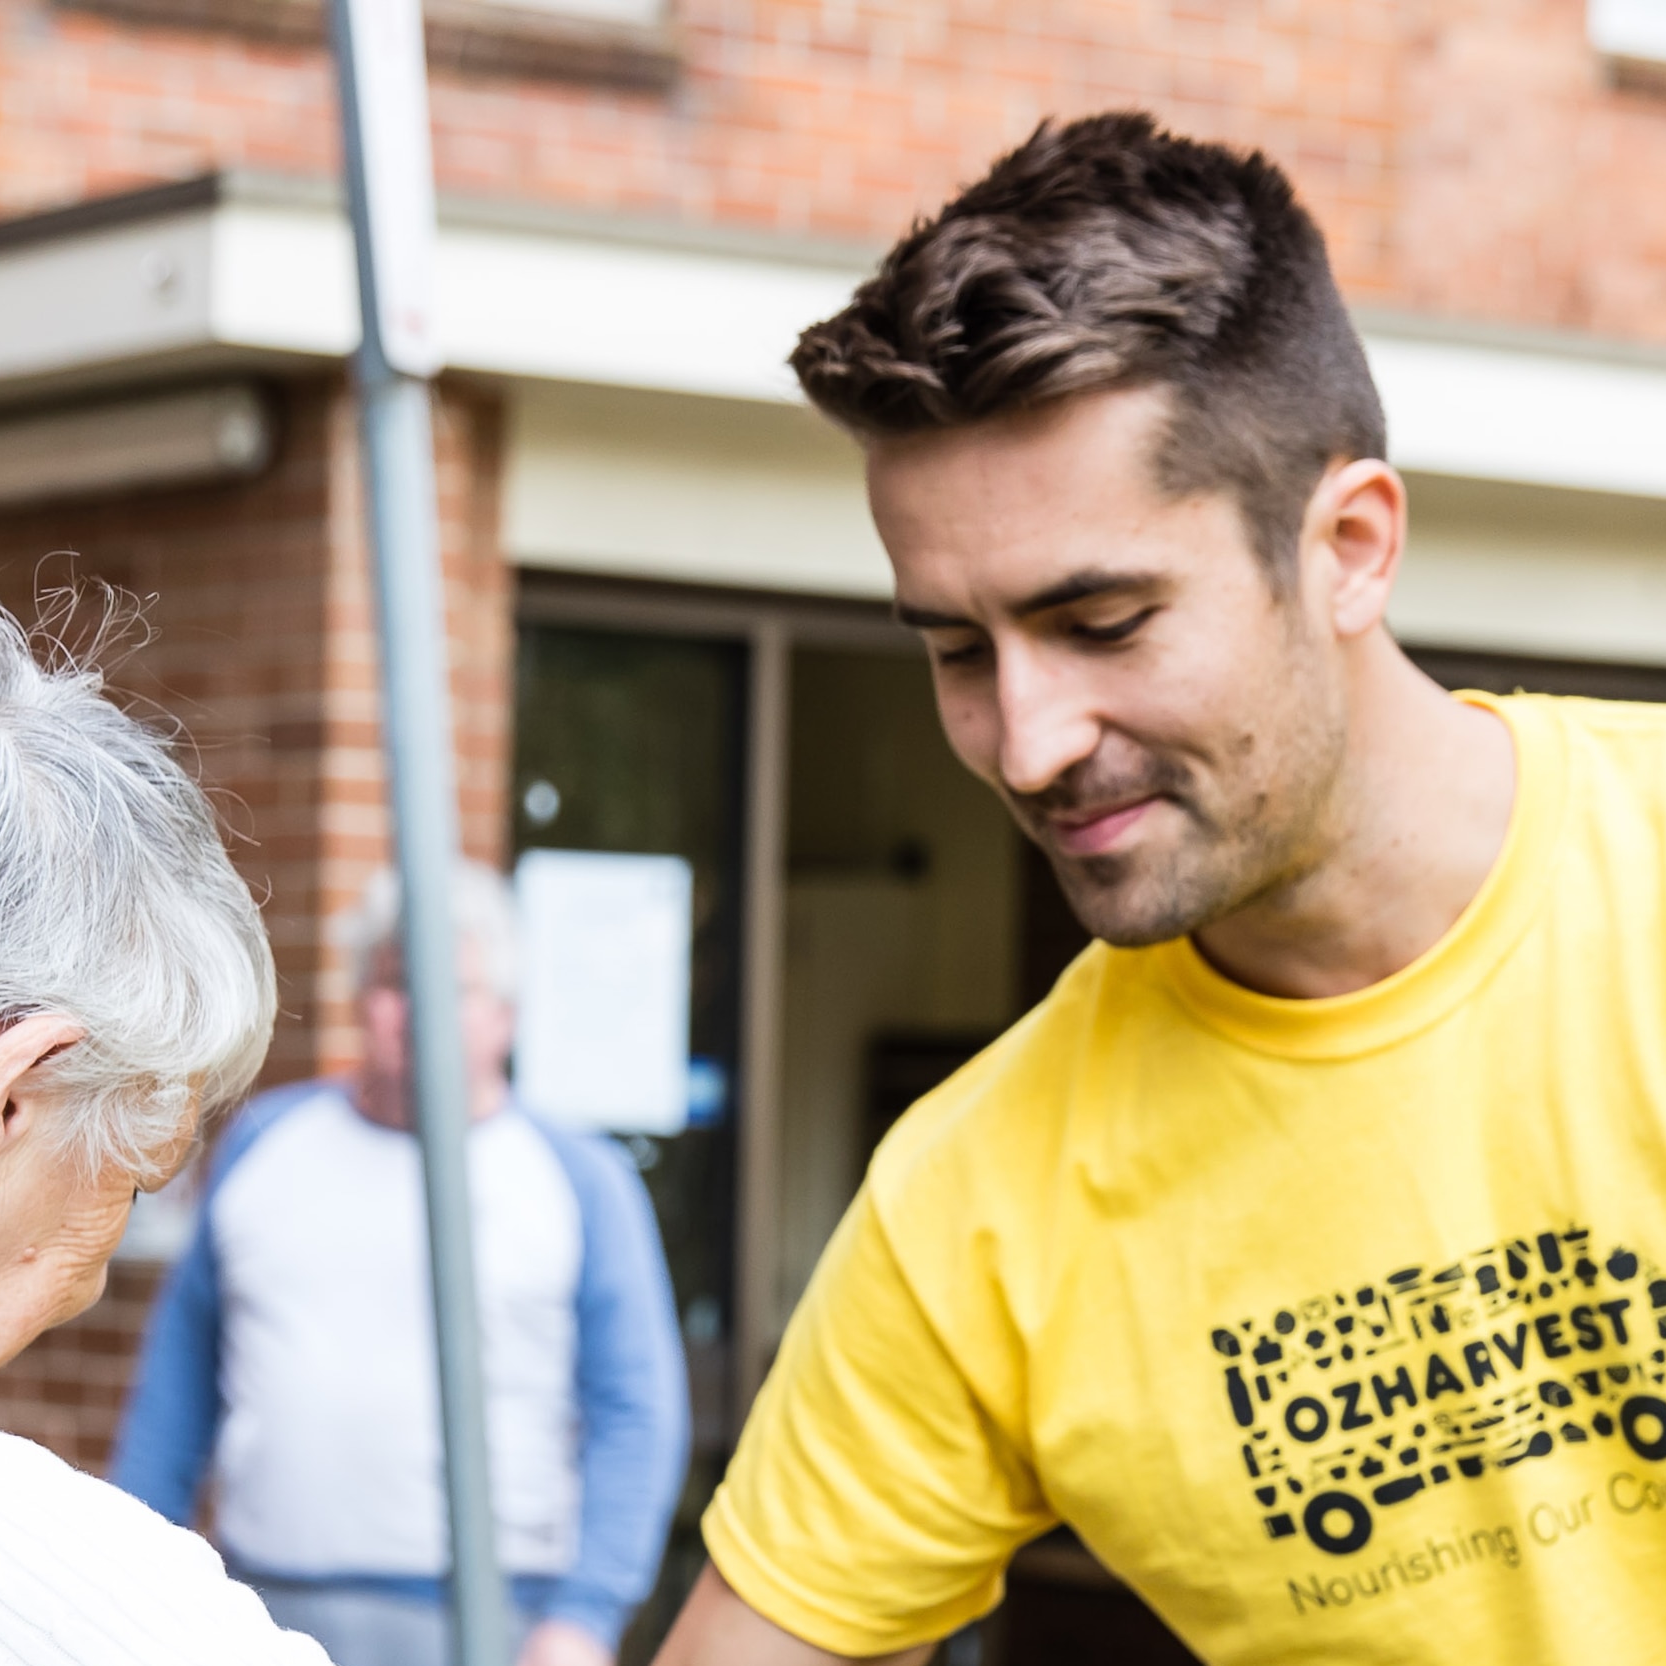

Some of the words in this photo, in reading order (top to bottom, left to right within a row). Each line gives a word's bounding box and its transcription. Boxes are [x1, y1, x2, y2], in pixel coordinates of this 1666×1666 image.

[1284, 1298, 1633, 1443] OZHARVEST
[1288, 1521, 1521, 1615] Nourishing
[1528, 1493, 1592, 1548] Our
